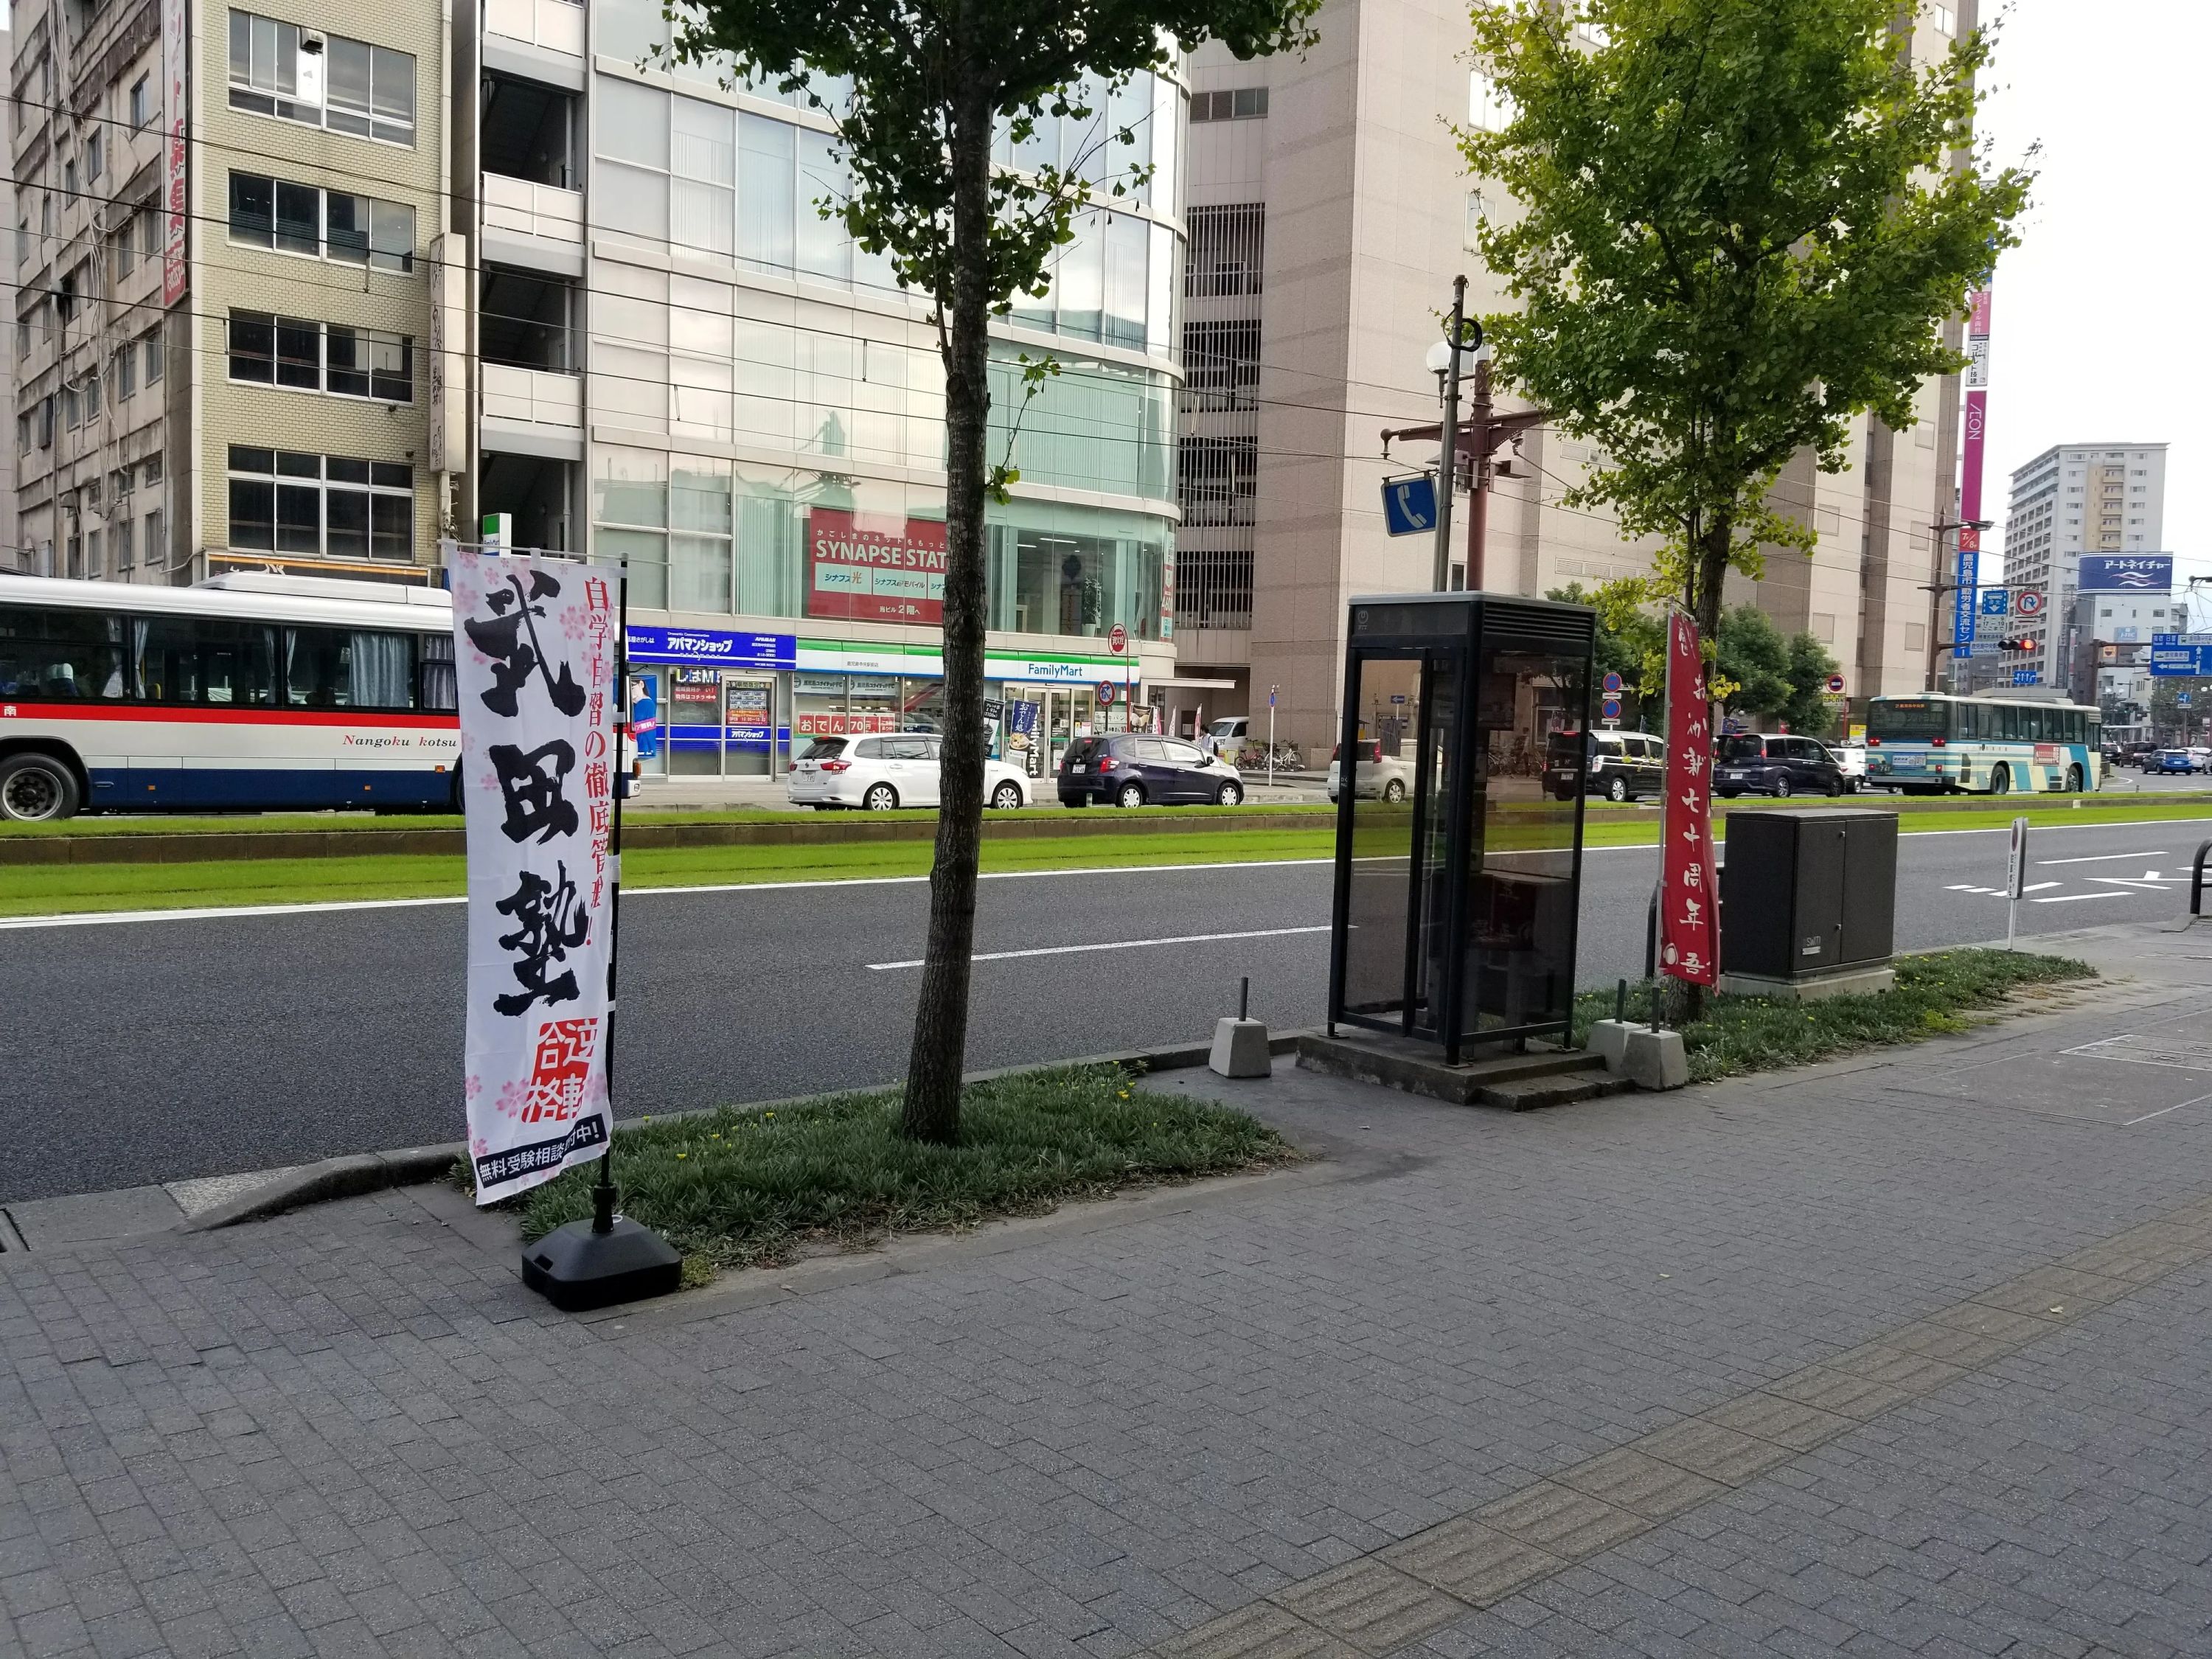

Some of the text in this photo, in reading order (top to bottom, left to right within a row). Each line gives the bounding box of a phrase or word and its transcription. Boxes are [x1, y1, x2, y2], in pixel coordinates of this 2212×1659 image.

[815, 539, 947, 569] SYNAPSE STAT
[2104, 560, 2171, 569] アートネイチャー
[667, 637, 732, 653] アパマンショップ
[1028, 664, 1083, 678] FamilyMart
[4, 705, 17, 717] 南
[801, 718, 844, 732] おでん
[850, 721, 863, 731] 70
[343, 734, 457, 748] Nangoku kotsu
[464, 570, 589, 1018] 武田塾
